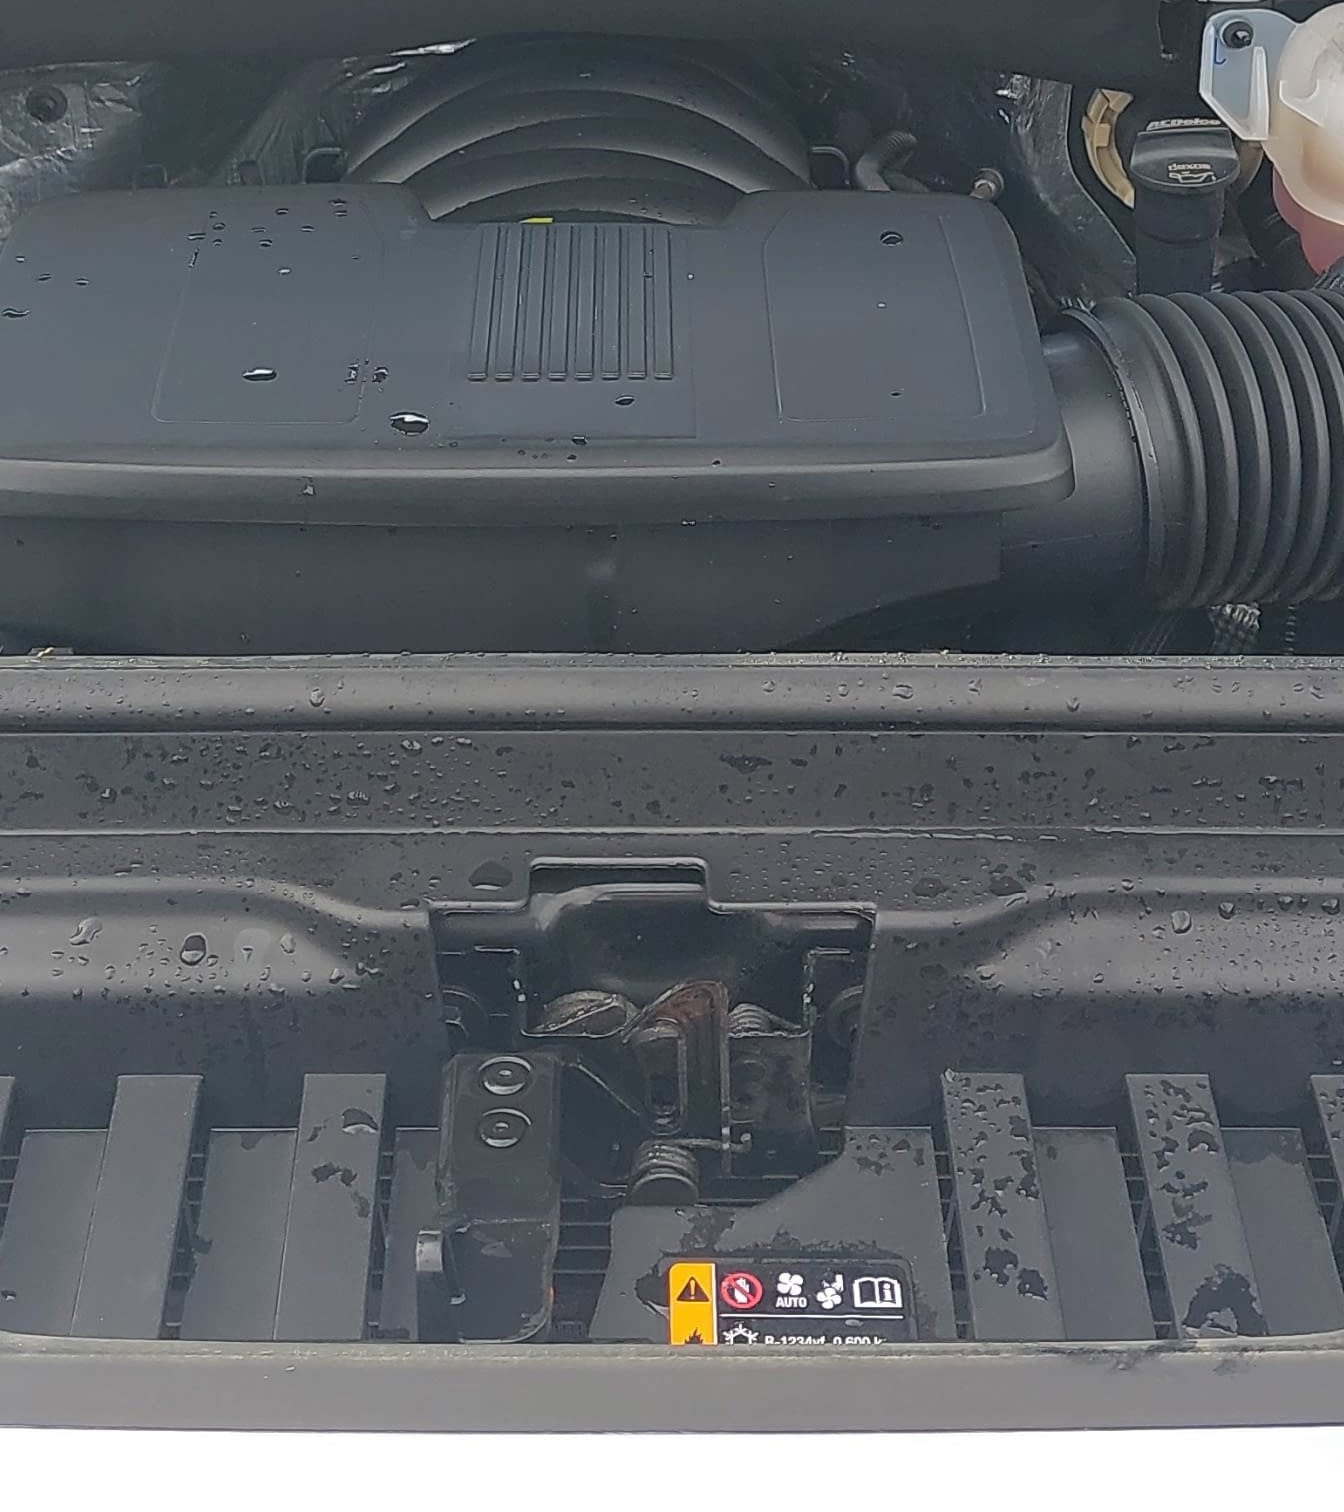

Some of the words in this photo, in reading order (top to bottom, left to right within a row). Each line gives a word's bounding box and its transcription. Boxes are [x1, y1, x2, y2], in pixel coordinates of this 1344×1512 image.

[1146, 117, 1222, 131] ACDelco
[775, 1296, 808, 1308] AUTO
[833, 1336, 871, 1345] 0600
